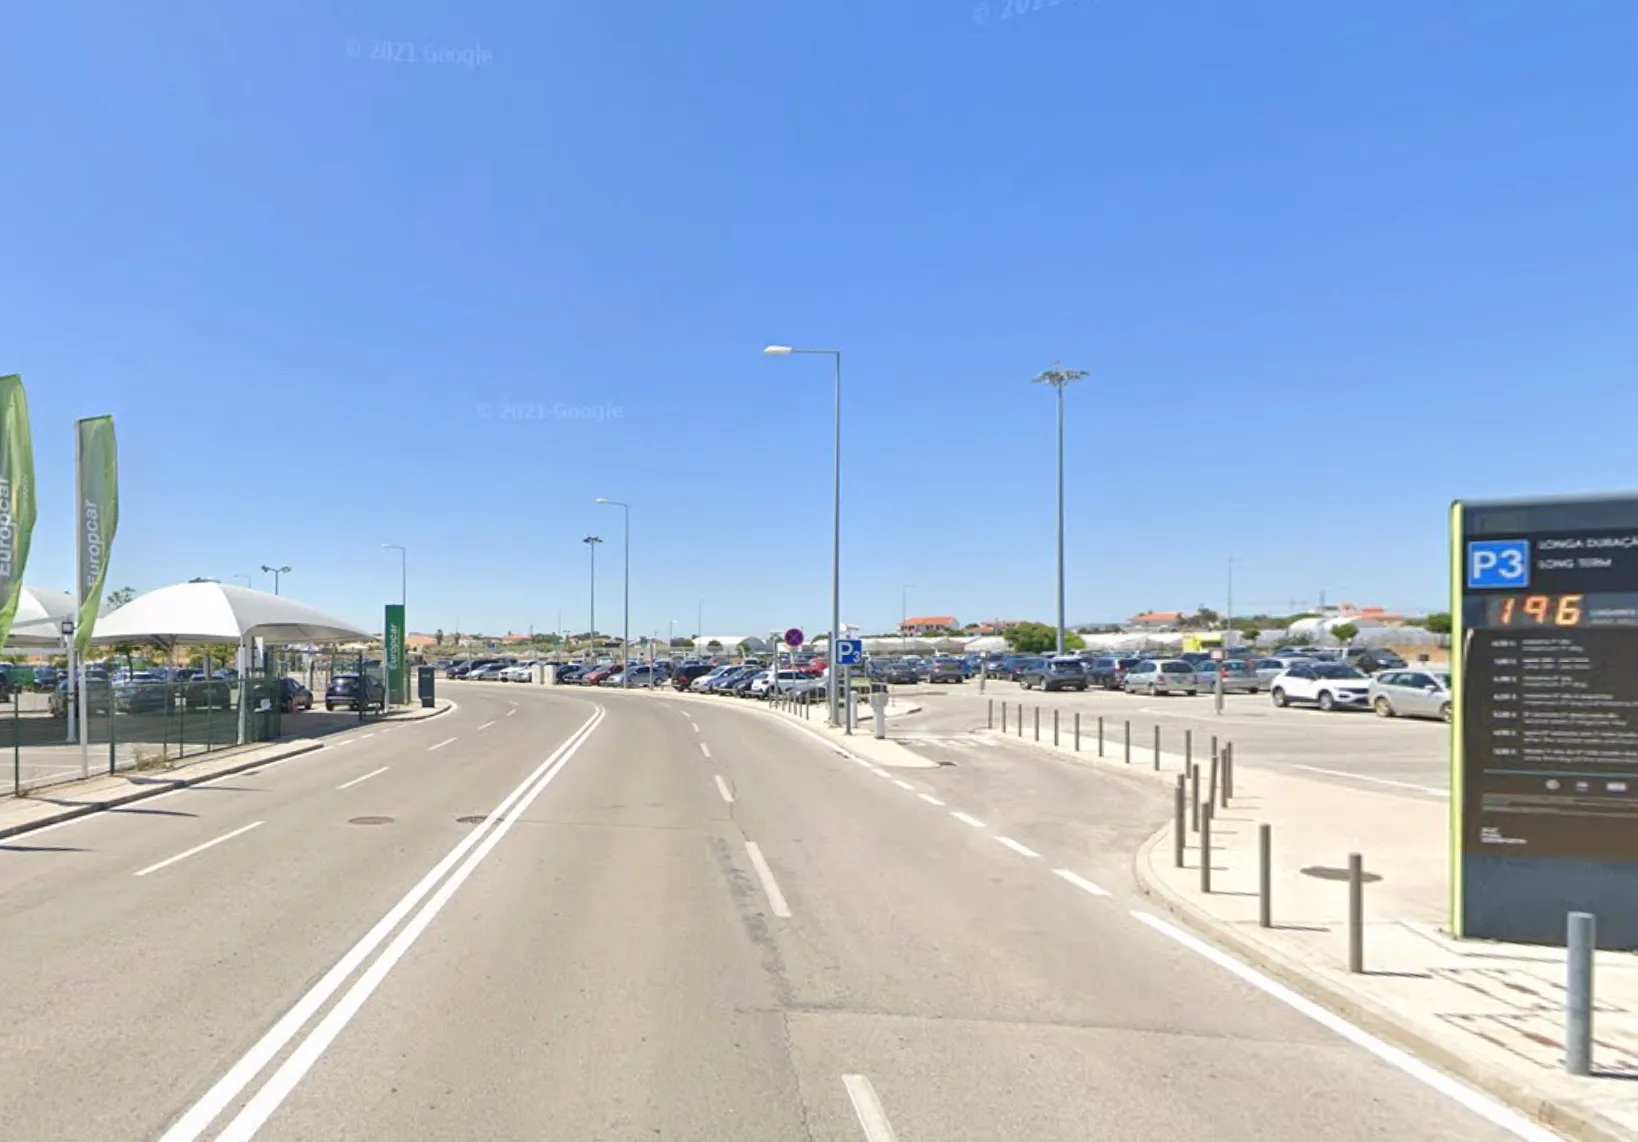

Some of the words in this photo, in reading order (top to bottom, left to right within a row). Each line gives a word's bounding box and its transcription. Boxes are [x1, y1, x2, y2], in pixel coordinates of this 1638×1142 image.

[85, 499, 106, 587] Europcar
[1538, 538, 1584, 550] LONGA
[1586, 535, 1638, 549] DURAÇÃ
[1472, 549, 1523, 579] P3
[1538, 558, 1574, 570] LONG
[1578, 557, 1613, 568] TERM
[1501, 594, 1584, 626] 196
[389, 623, 398, 670] Europcar
